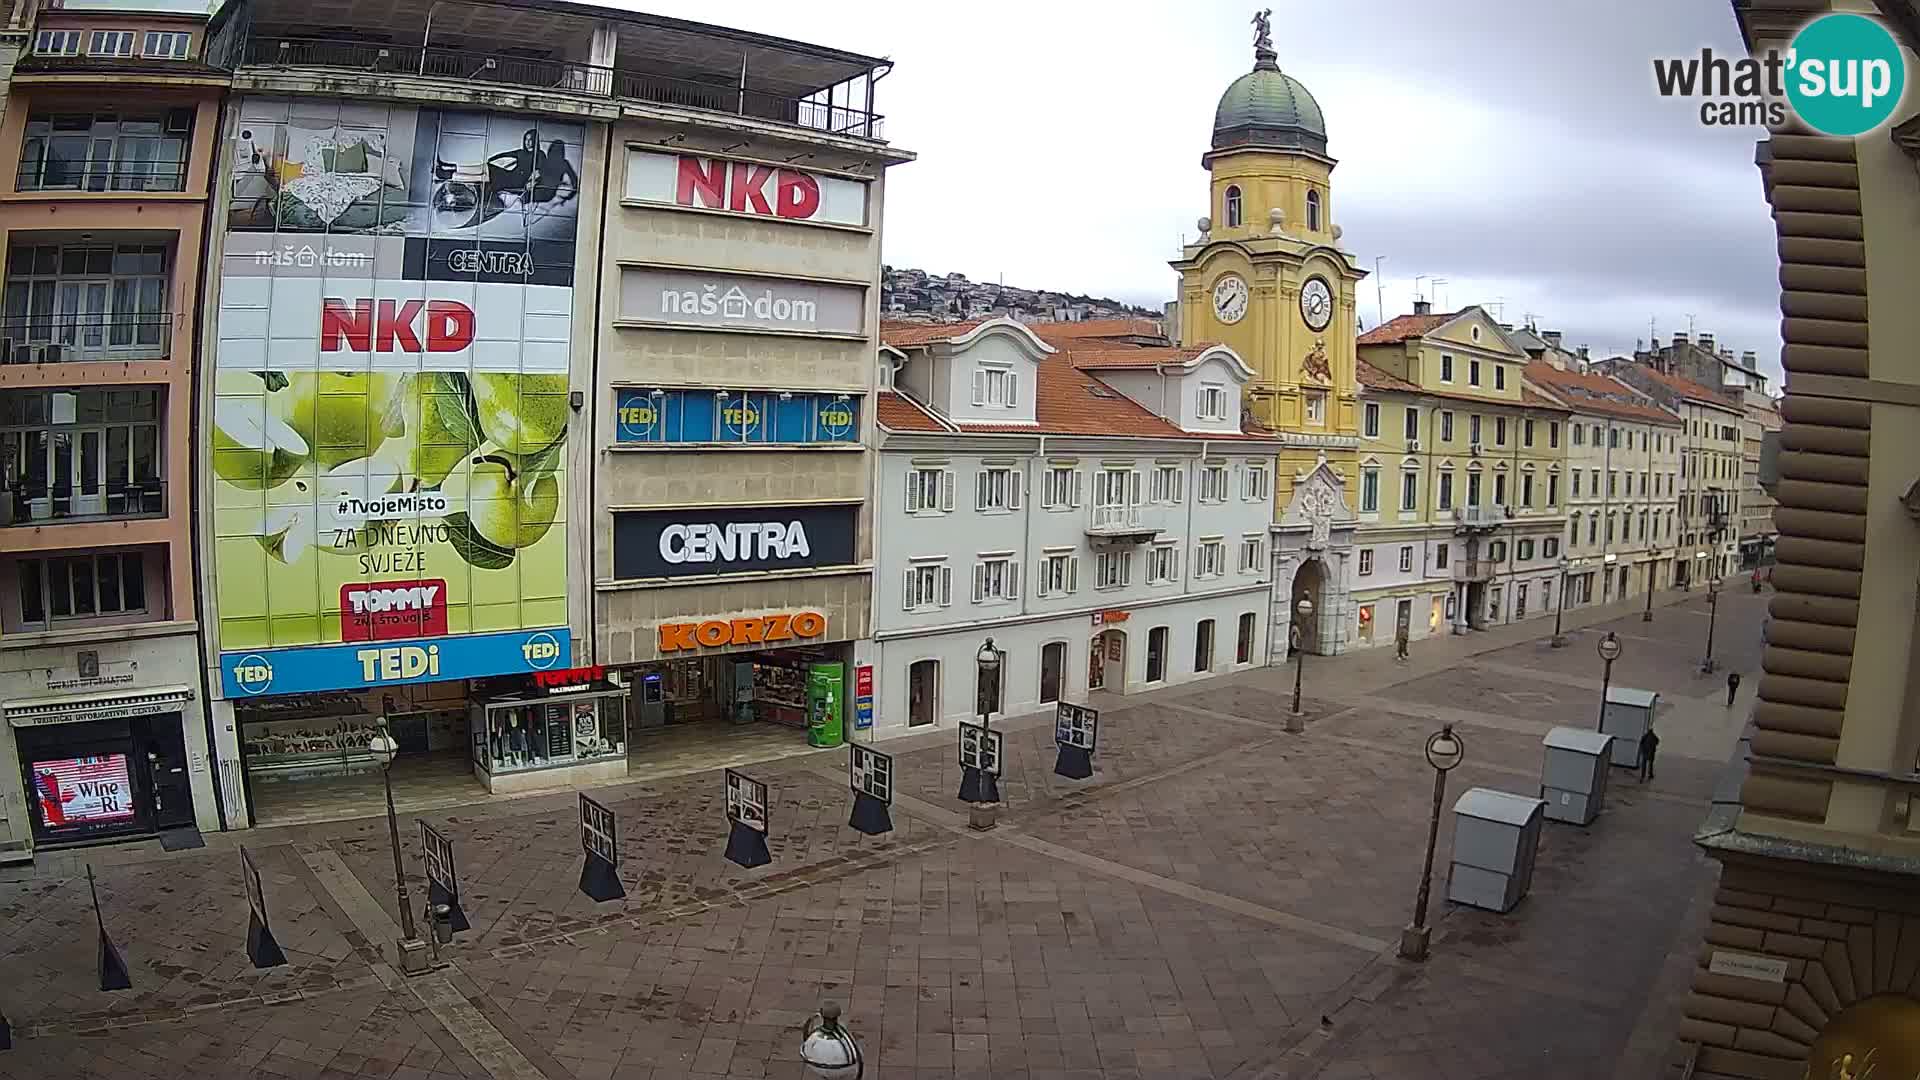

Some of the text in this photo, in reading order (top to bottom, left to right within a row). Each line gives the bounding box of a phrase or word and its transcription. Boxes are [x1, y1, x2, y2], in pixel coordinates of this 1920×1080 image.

[675, 154, 821, 219] NKD
[254, 245, 366, 269] naš dom
[447, 248, 536, 276] CENTRA
[661, 283, 817, 322] naš dom
[319, 297, 477, 353] NKD
[618, 407, 657, 425] TEDi
[723, 408, 760, 425] TEDi
[820, 411, 852, 426] TEDi
[337, 497, 446, 516] #TvojeMisto
[333, 523, 450, 548] ZA DNEVNO
[658, 520, 811, 564] CENTRA
[359, 546, 426, 575] SVJEŽE
[348, 585, 440, 614] TOMMY
[658, 611, 826, 653] KORZO
[357, 645, 440, 682] TEDi
[521, 642, 560, 660] TEDi
[233, 664, 273, 683] TEDi
[77, 781, 119, 799] Wine
[101, 796, 119, 813] Ri
